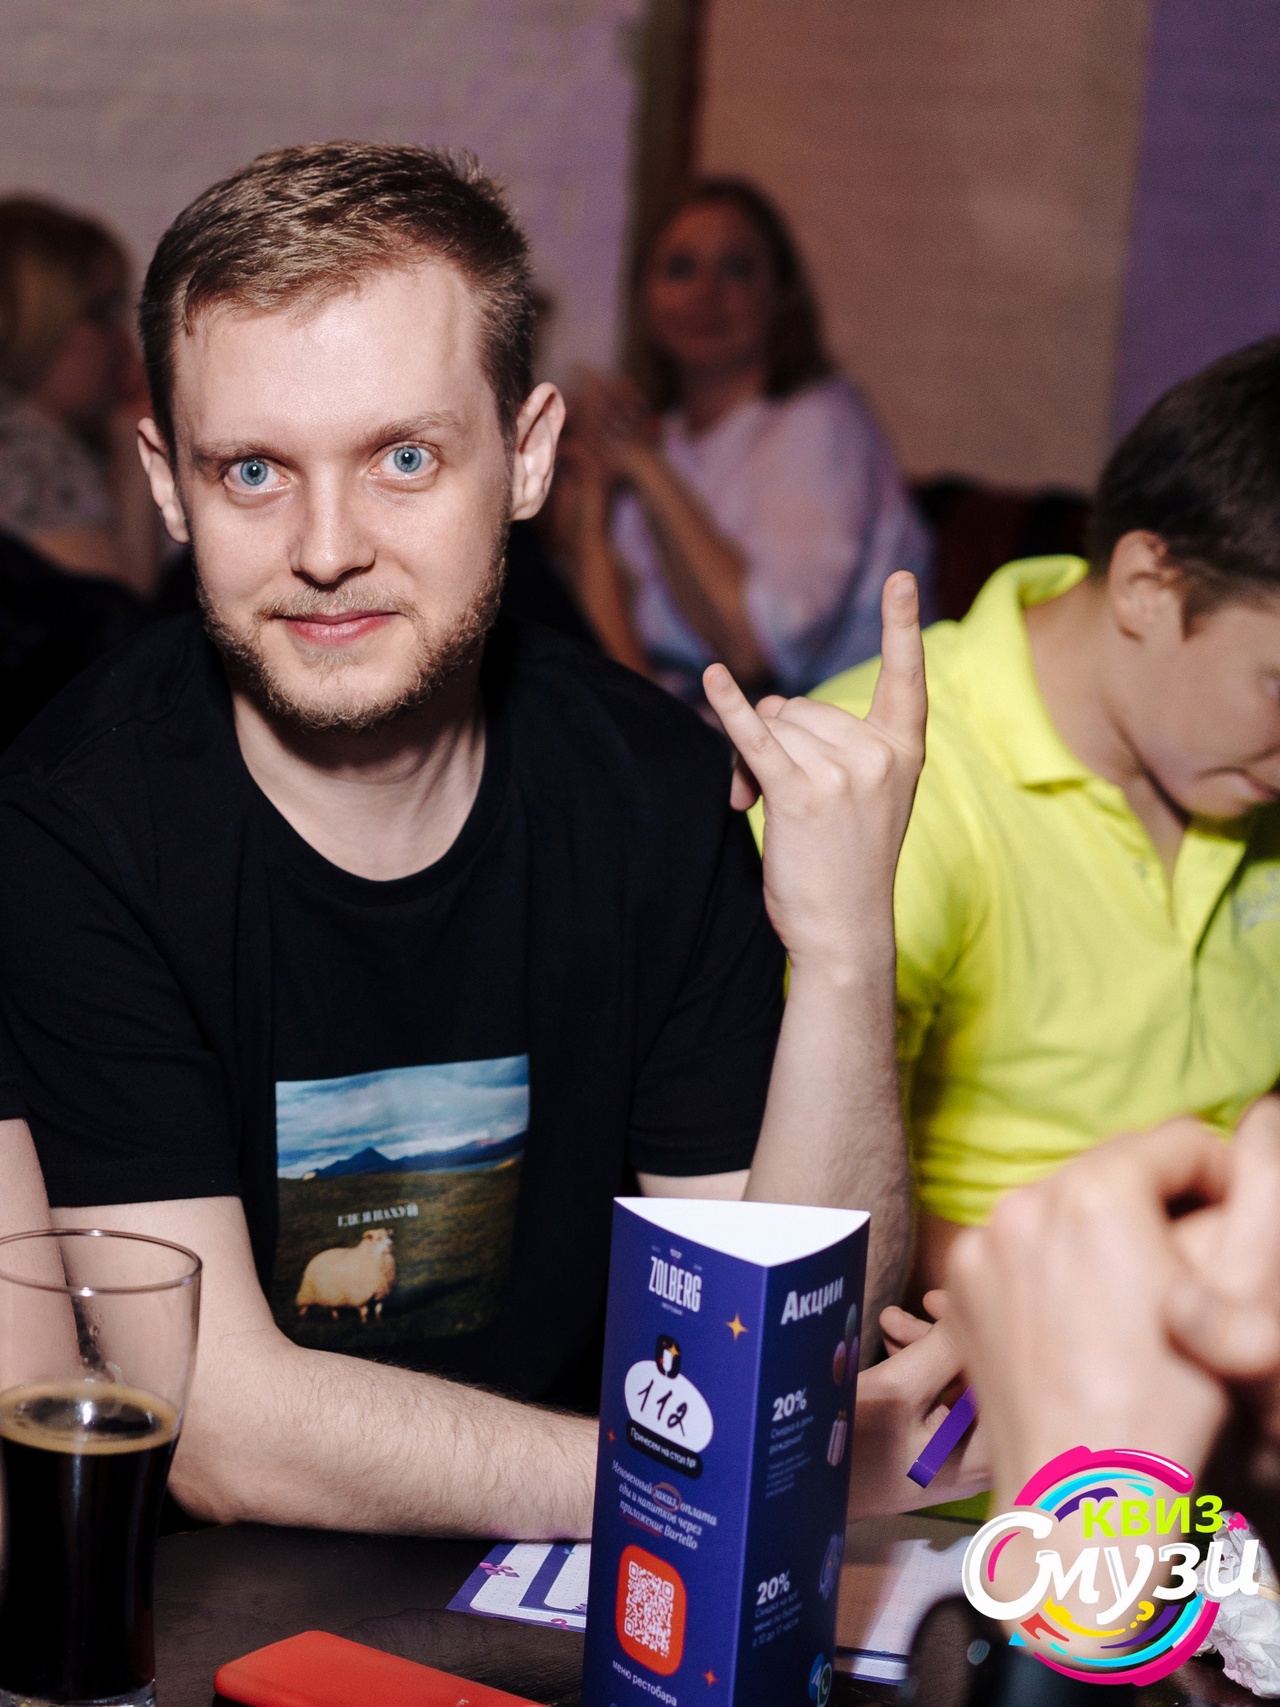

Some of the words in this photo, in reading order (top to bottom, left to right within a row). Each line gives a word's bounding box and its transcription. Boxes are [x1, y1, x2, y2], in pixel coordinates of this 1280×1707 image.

[648, 1255, 702, 1312] ZOLBERG
[637, 1379, 688, 1437] 112
[772, 1387, 807, 1422] 20%
[669, 1450, 686, 1466] стол
[620, 1500, 664, 1534] приложение
[664, 1524, 698, 1550] Bartello
[637, 1494, 677, 1525] напитков
[678, 1516, 702, 1536] через
[680, 1502, 718, 1526] оплата
[756, 1569, 791, 1606] 20%
[612, 1660, 632, 1679] меню
[632, 1674, 677, 1706] рестобара
